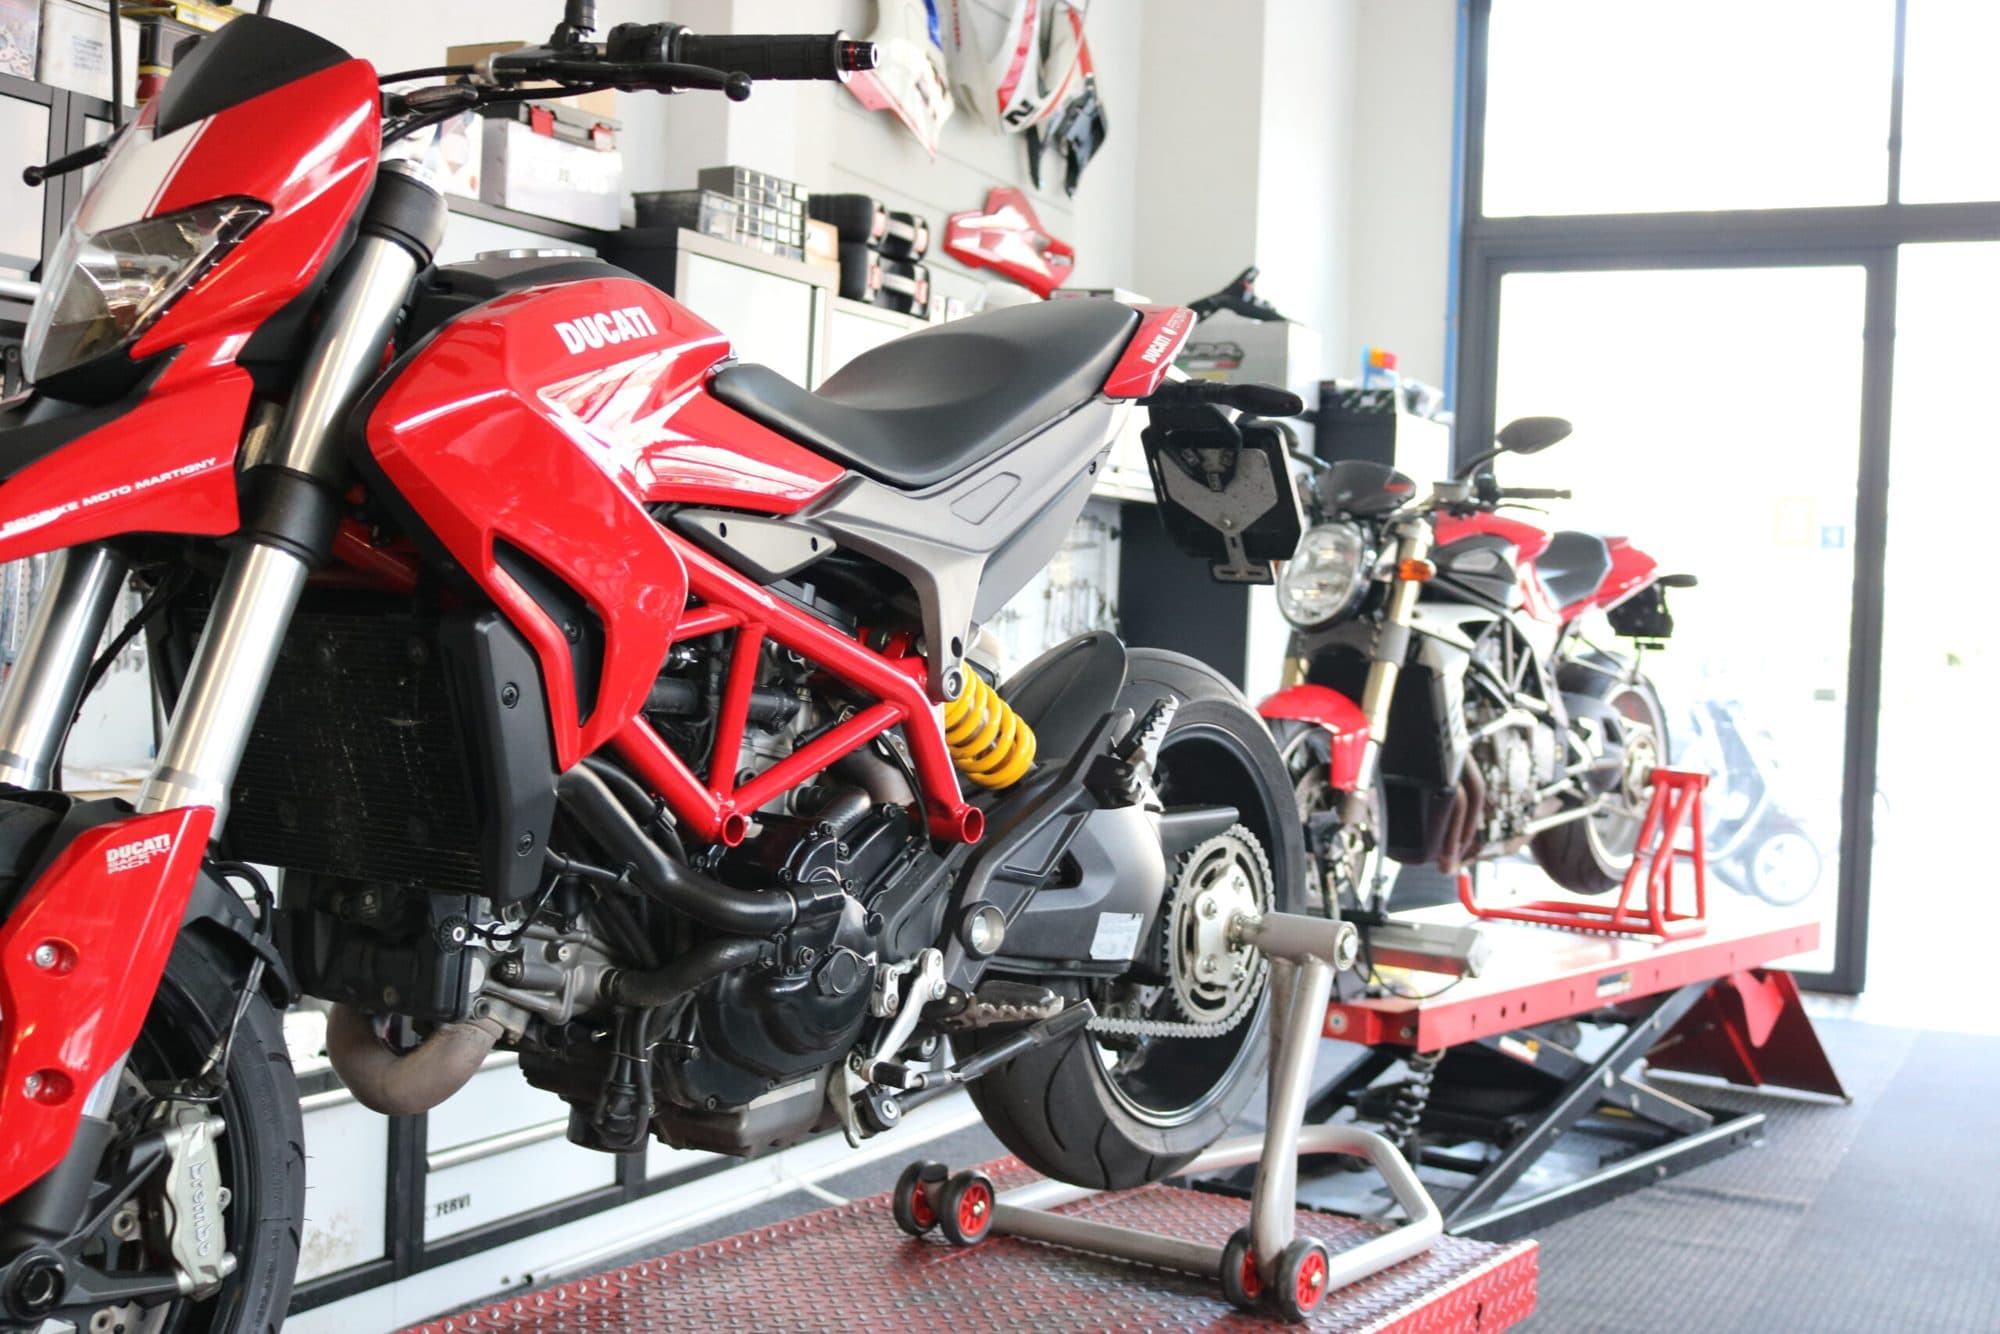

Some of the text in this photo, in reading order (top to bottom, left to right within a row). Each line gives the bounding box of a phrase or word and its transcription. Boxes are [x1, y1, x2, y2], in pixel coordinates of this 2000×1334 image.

[552, 305, 659, 356] DUCATI
[1140, 333, 1173, 365] DUCATI
[82, 485, 132, 507] MOTO
[135, 457, 217, 490] MARTIGNY
[106, 833, 171, 863] DUCATI
[189, 1160, 213, 1257] brembo
